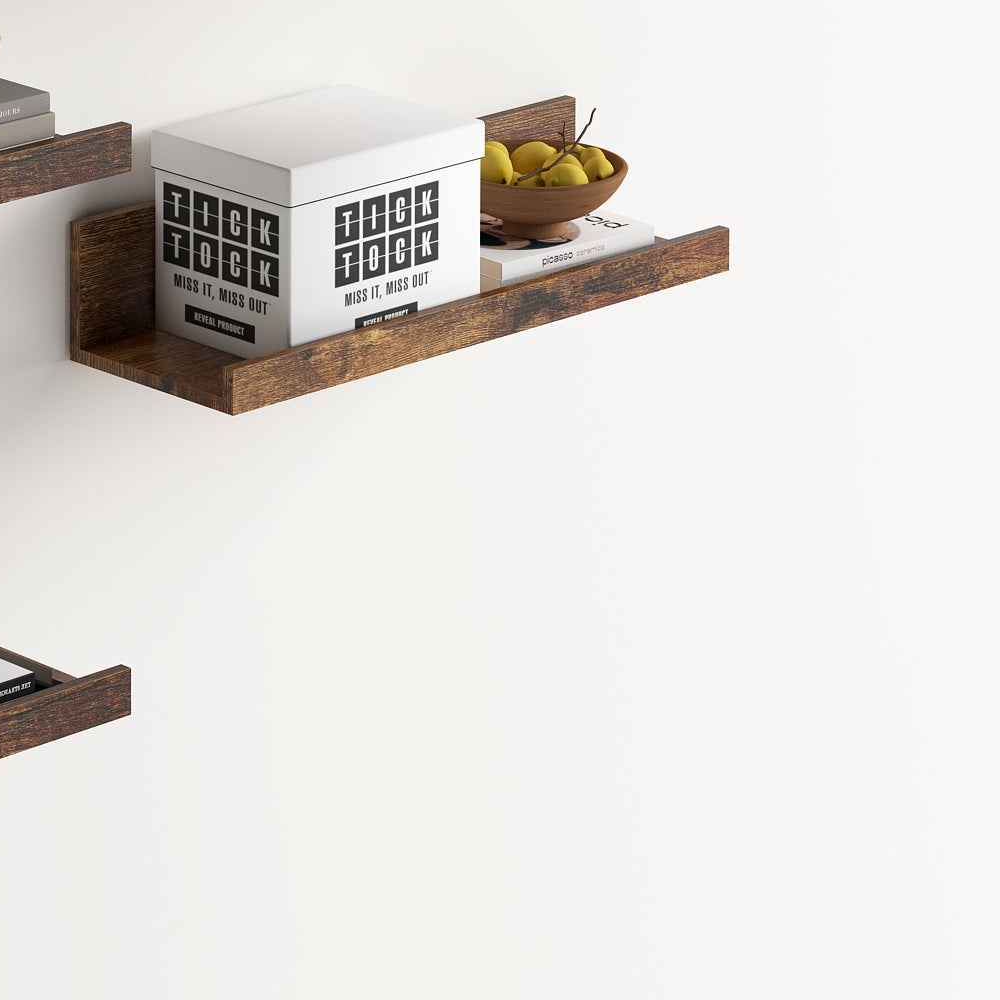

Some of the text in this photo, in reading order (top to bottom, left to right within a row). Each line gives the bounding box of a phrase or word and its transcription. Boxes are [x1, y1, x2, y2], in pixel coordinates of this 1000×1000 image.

[0, 106, 21, 119] JOURS
[170, 190, 272, 247] TICK
[341, 188, 433, 238] TICK
[170, 232, 272, 289] TOCK
[341, 229, 433, 280] TOCK
[541, 243, 605, 268] picasso ceramics
[174, 272, 268, 316] MISS IT, MISS OUT
[344, 271, 429, 307] MISS IT, MISS OUT
[193, 311, 245, 336] REVEAL PRODUCT
